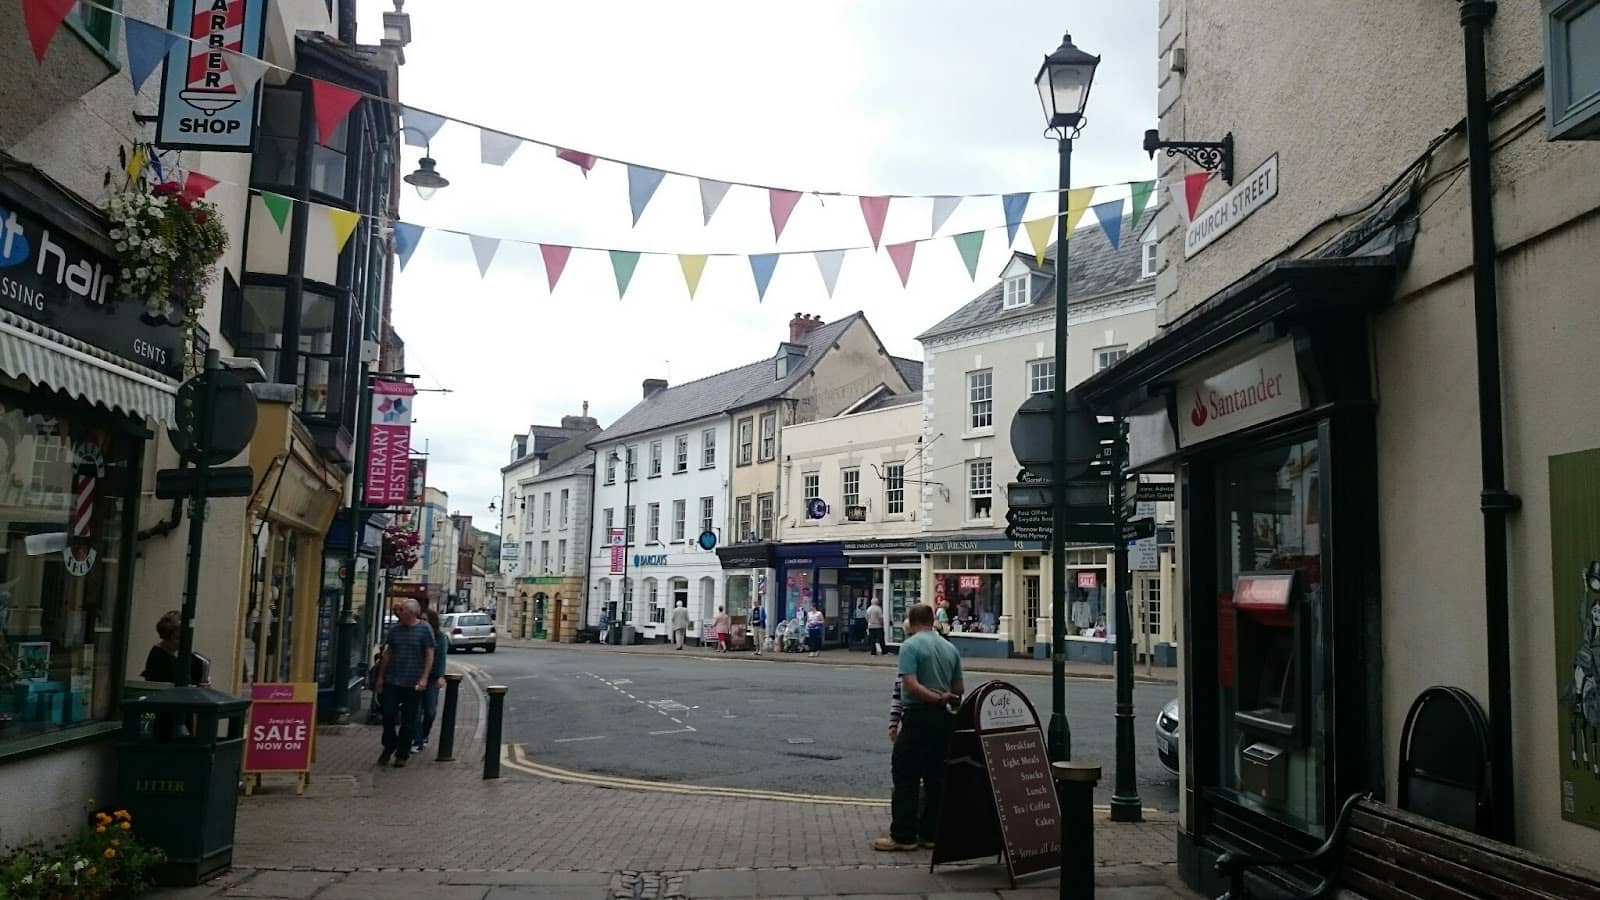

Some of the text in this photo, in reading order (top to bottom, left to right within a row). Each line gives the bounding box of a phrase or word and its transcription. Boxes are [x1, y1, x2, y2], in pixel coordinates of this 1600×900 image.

[205, 0, 227, 88] ARBER
[179, 118, 241, 134] SHOP
[1188, 168, 1271, 248] CHURCH STREET
[36, 229, 115, 305] hair
[1, 276, 45, 311] SSING
[133, 338, 166, 365] GENTS
[1208, 367, 1283, 421] Santander
[369, 426, 389, 500] LITERARY
[388, 429, 409, 500] FESTIVAL
[640, 554, 667, 566] BARCLAYS
[960, 579, 980, 588] SALE
[254, 724, 307, 742] SALE
[256, 741, 302, 751] NOW ON
[1004, 740, 1036, 752] Breakfast
[1002, 754, 1040, 769] Light Meals
[1020, 769, 1044, 781] Snacks
[136, 779, 185, 792] LITTER
[1025, 784, 1047, 797] Lunch
[1029, 800, 1051, 812] Coffee
[1035, 816, 1056, 827] Cakes
